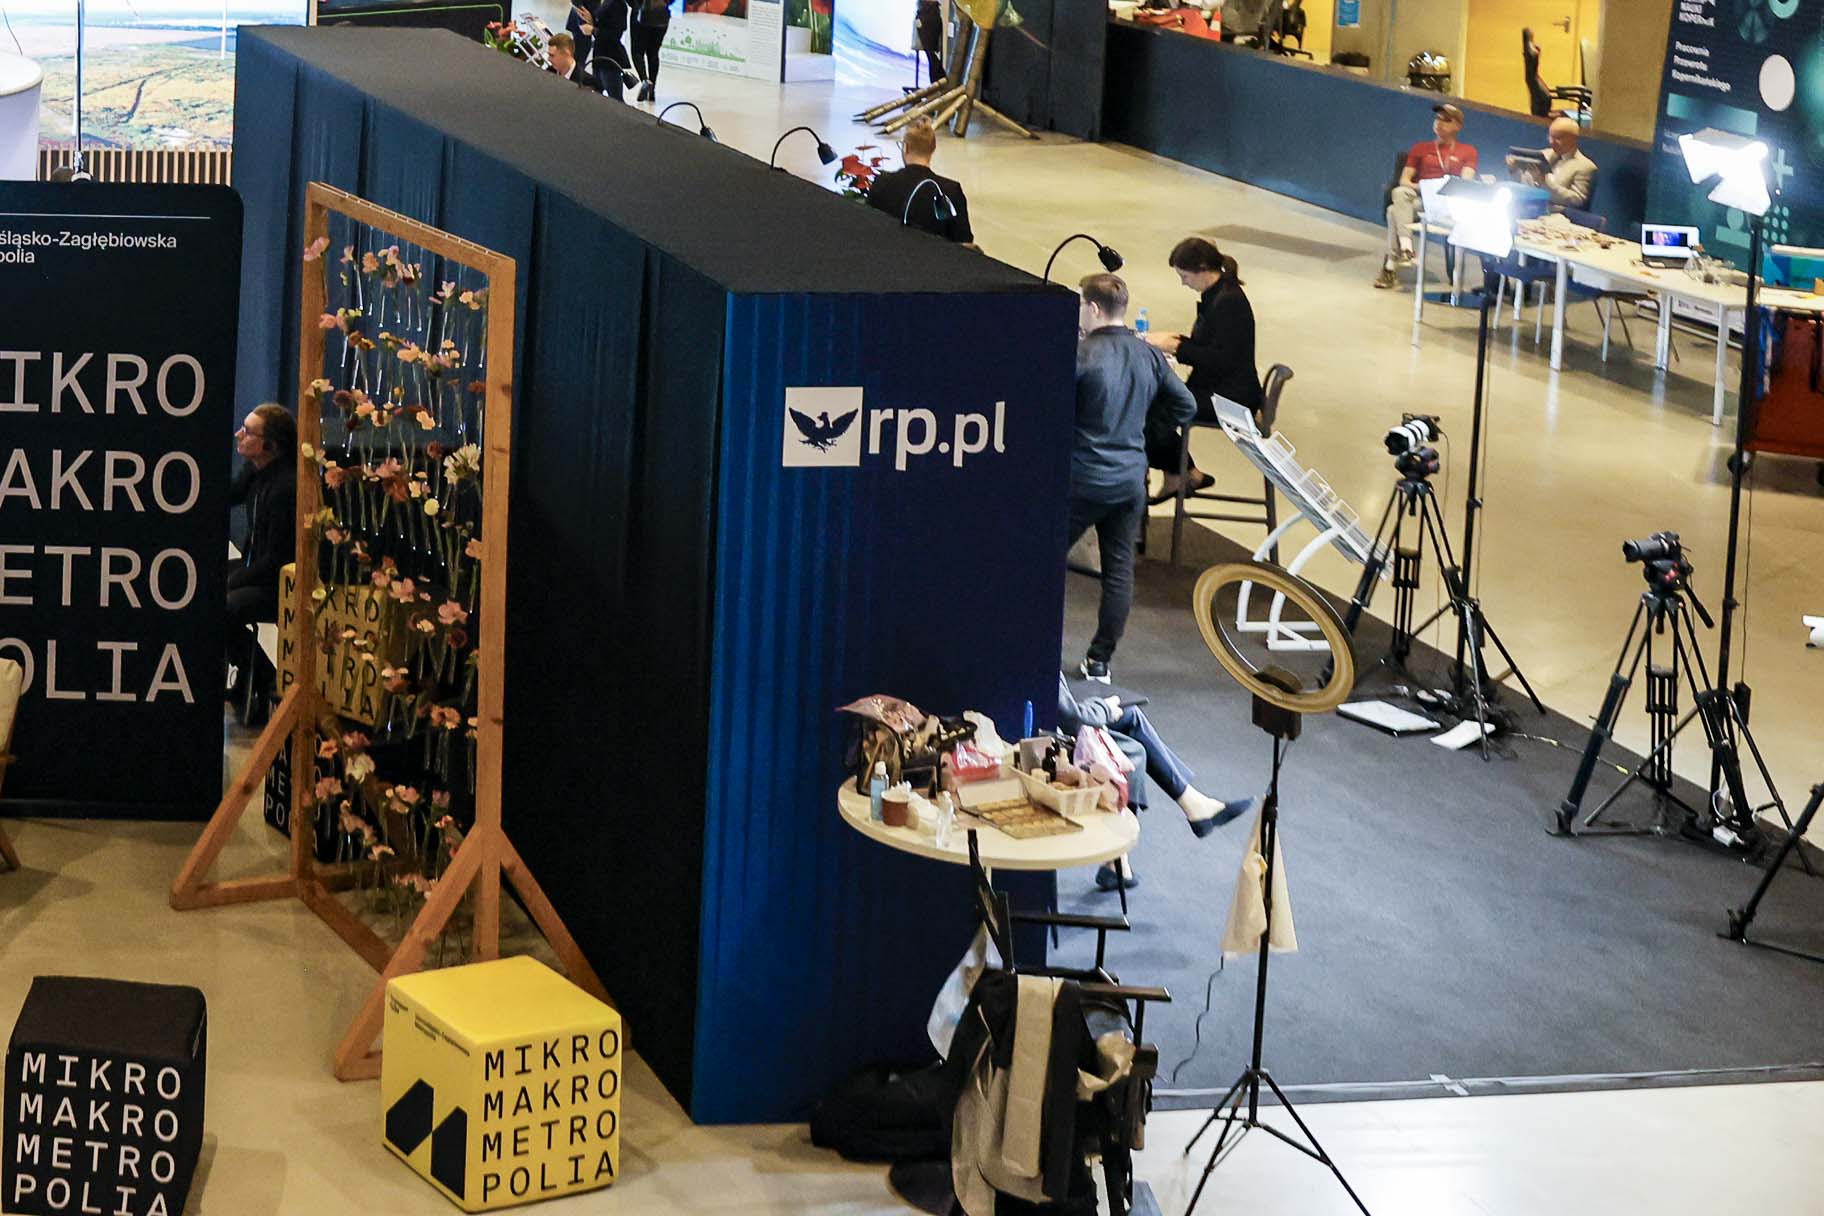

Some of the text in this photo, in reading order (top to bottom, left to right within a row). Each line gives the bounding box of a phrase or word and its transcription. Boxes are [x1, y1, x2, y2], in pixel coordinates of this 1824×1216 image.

[868, 400, 1006, 471] rp.pl
[21, 1052, 181, 1100] MIKRO
[485, 1029, 619, 1081] MIKRO
[19, 1092, 179, 1142] MAKRO
[483, 1069, 618, 1122] MAKRO
[16, 1133, 176, 1183] METRO
[482, 1110, 616, 1163] METRO
[14, 1173, 169, 1216] POLIA
[483, 1150, 614, 1203] POLIA
